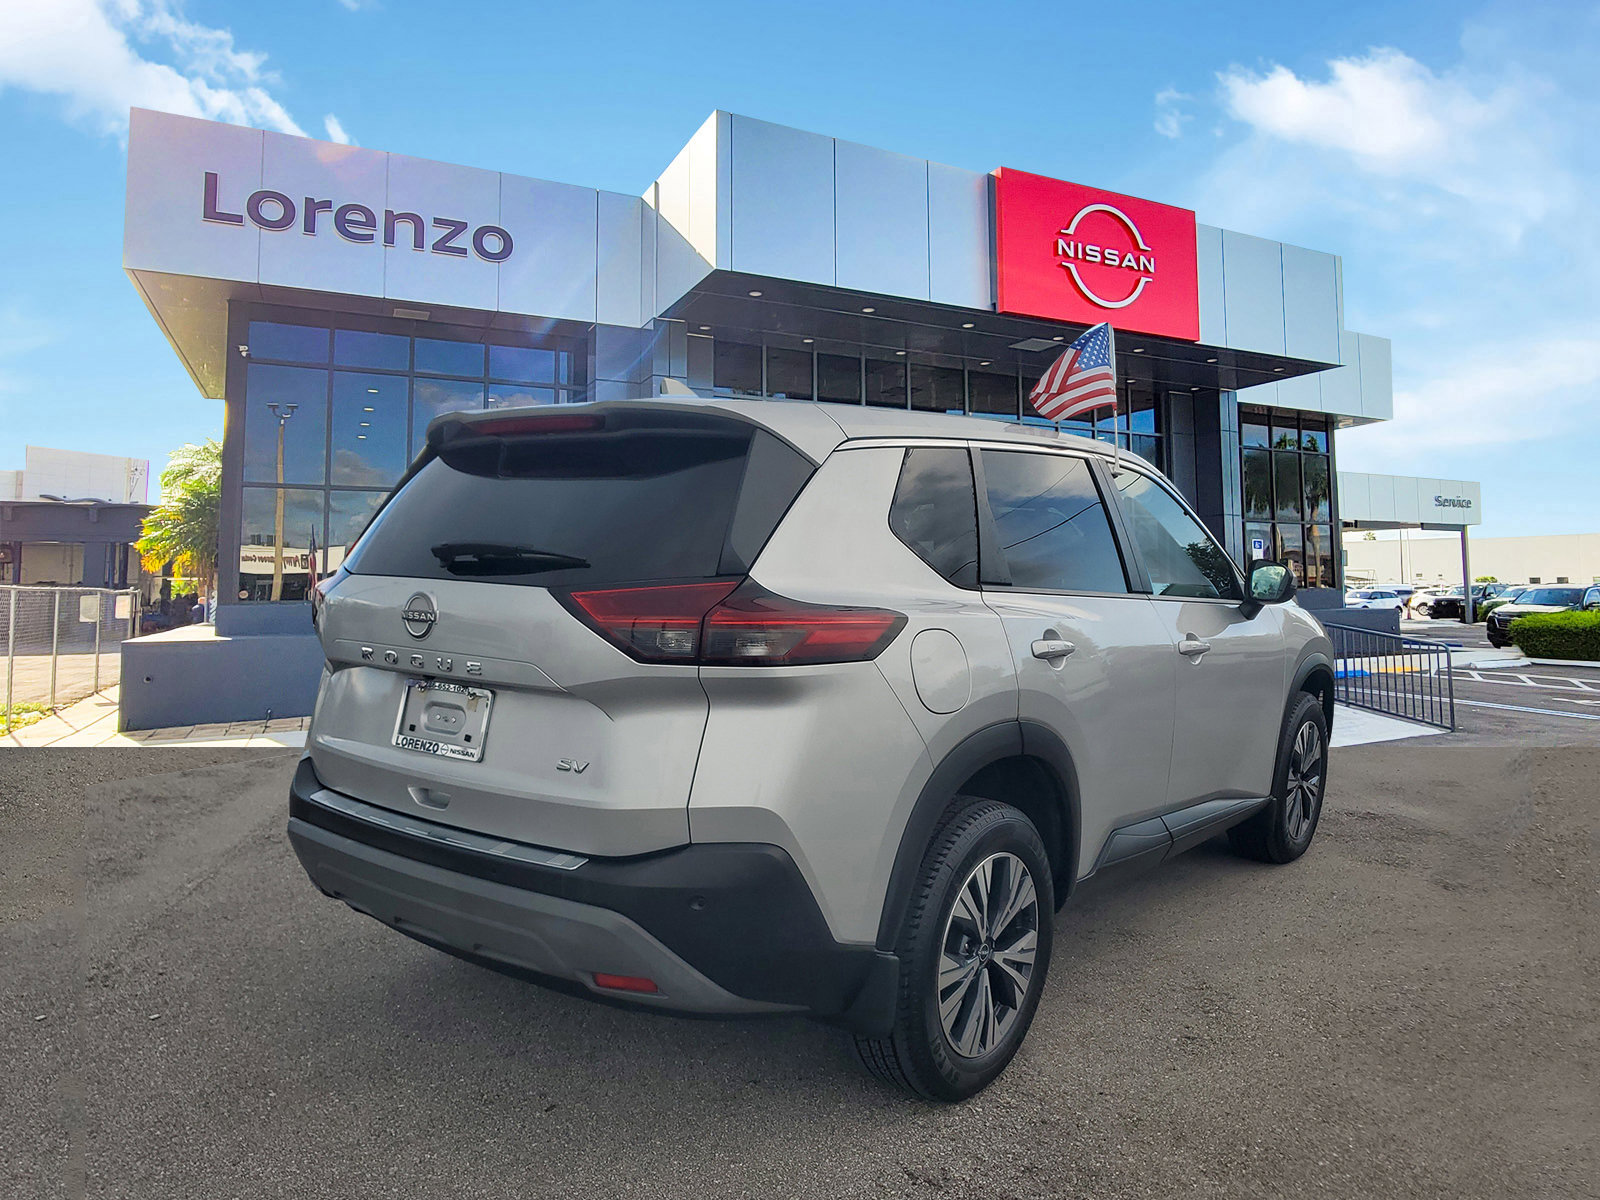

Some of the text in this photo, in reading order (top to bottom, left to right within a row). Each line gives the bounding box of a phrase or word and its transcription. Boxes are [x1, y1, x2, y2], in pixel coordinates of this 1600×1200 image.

[202, 171, 514, 262] Lorenzo
[1056, 238, 1155, 273] NISSAN
[1434, 495, 1472, 508] Service
[361, 647, 482, 675] ROGUE
[395, 735, 475, 758] LORENZO NISSAN
[556, 758, 590, 774] SV
